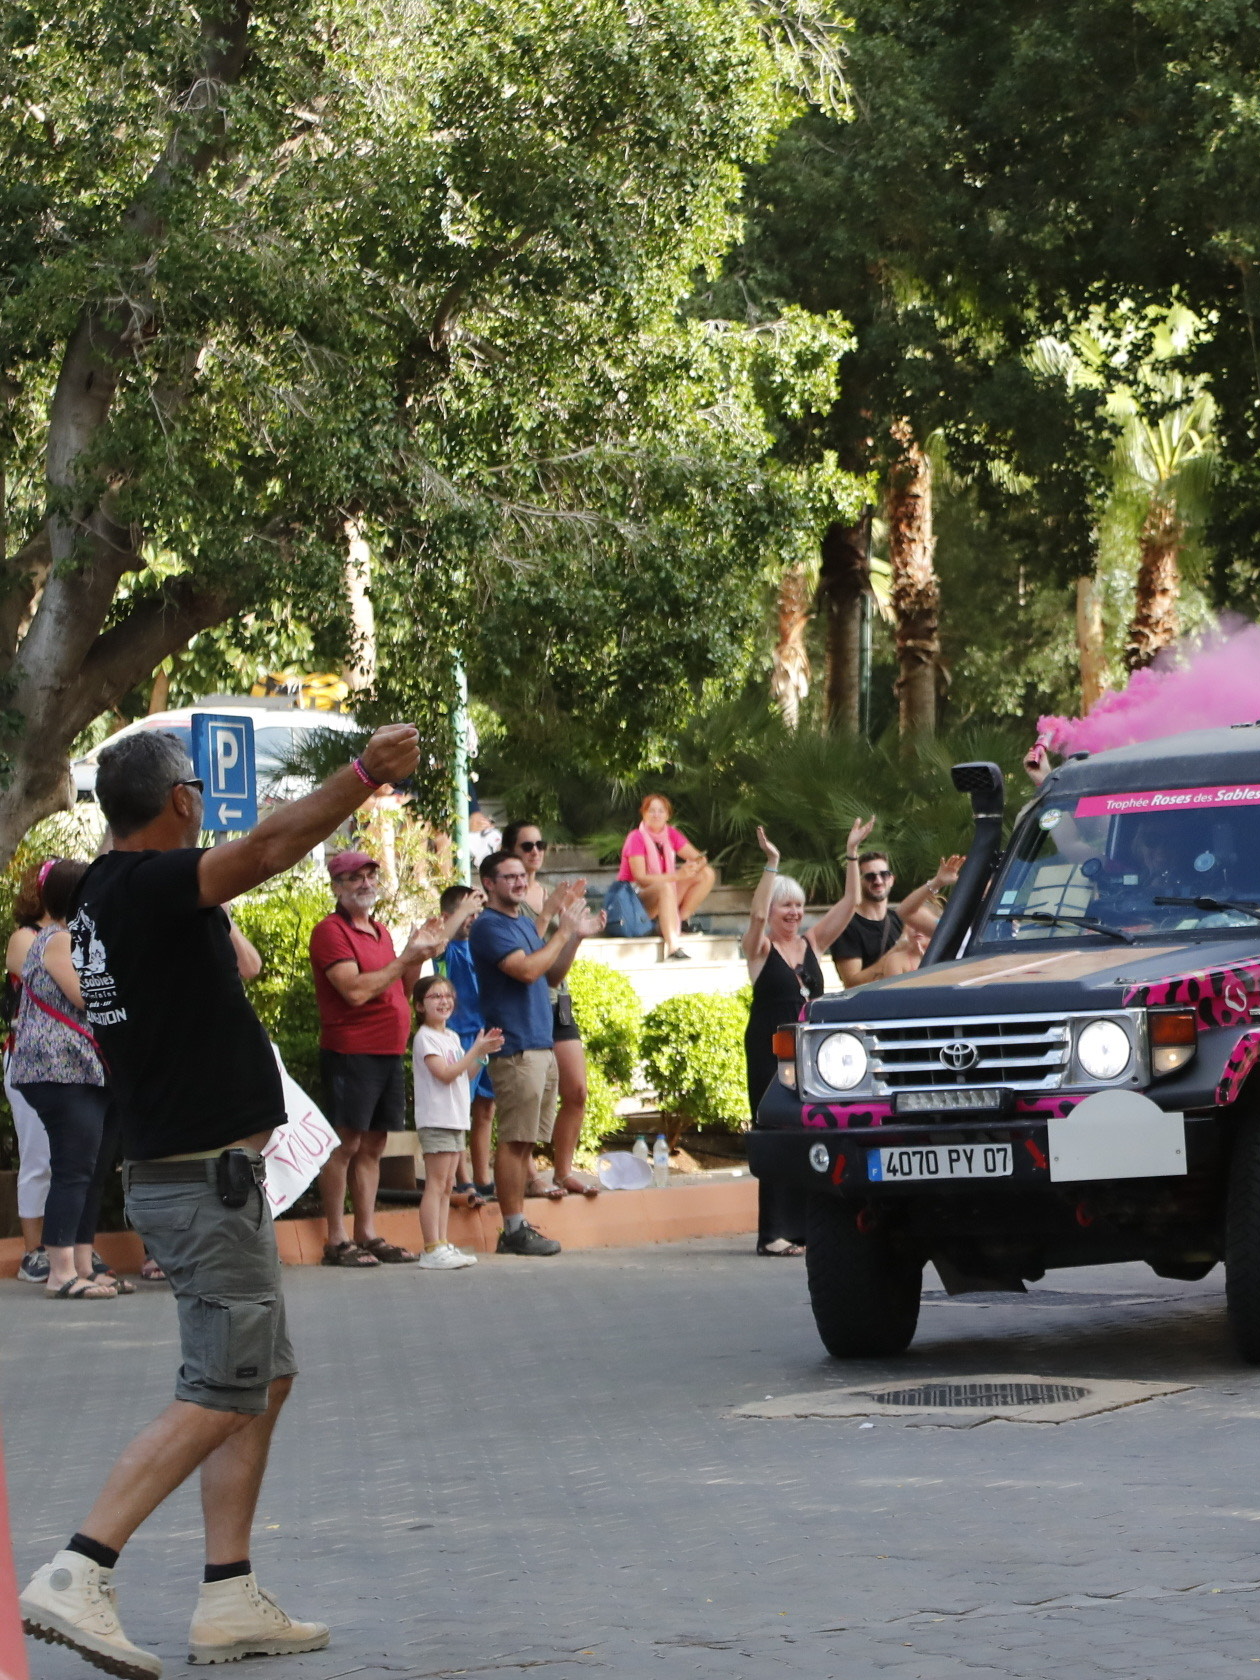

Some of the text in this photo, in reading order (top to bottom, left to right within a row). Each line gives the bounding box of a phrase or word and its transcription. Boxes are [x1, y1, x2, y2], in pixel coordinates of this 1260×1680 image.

[217, 730, 239, 790] P
[1106, 798, 1149, 811] Trophée
[1151, 793, 1192, 806] Roses
[1193, 792, 1212, 803] des
[886, 1147, 1008, 1177] 4070 PY 07
